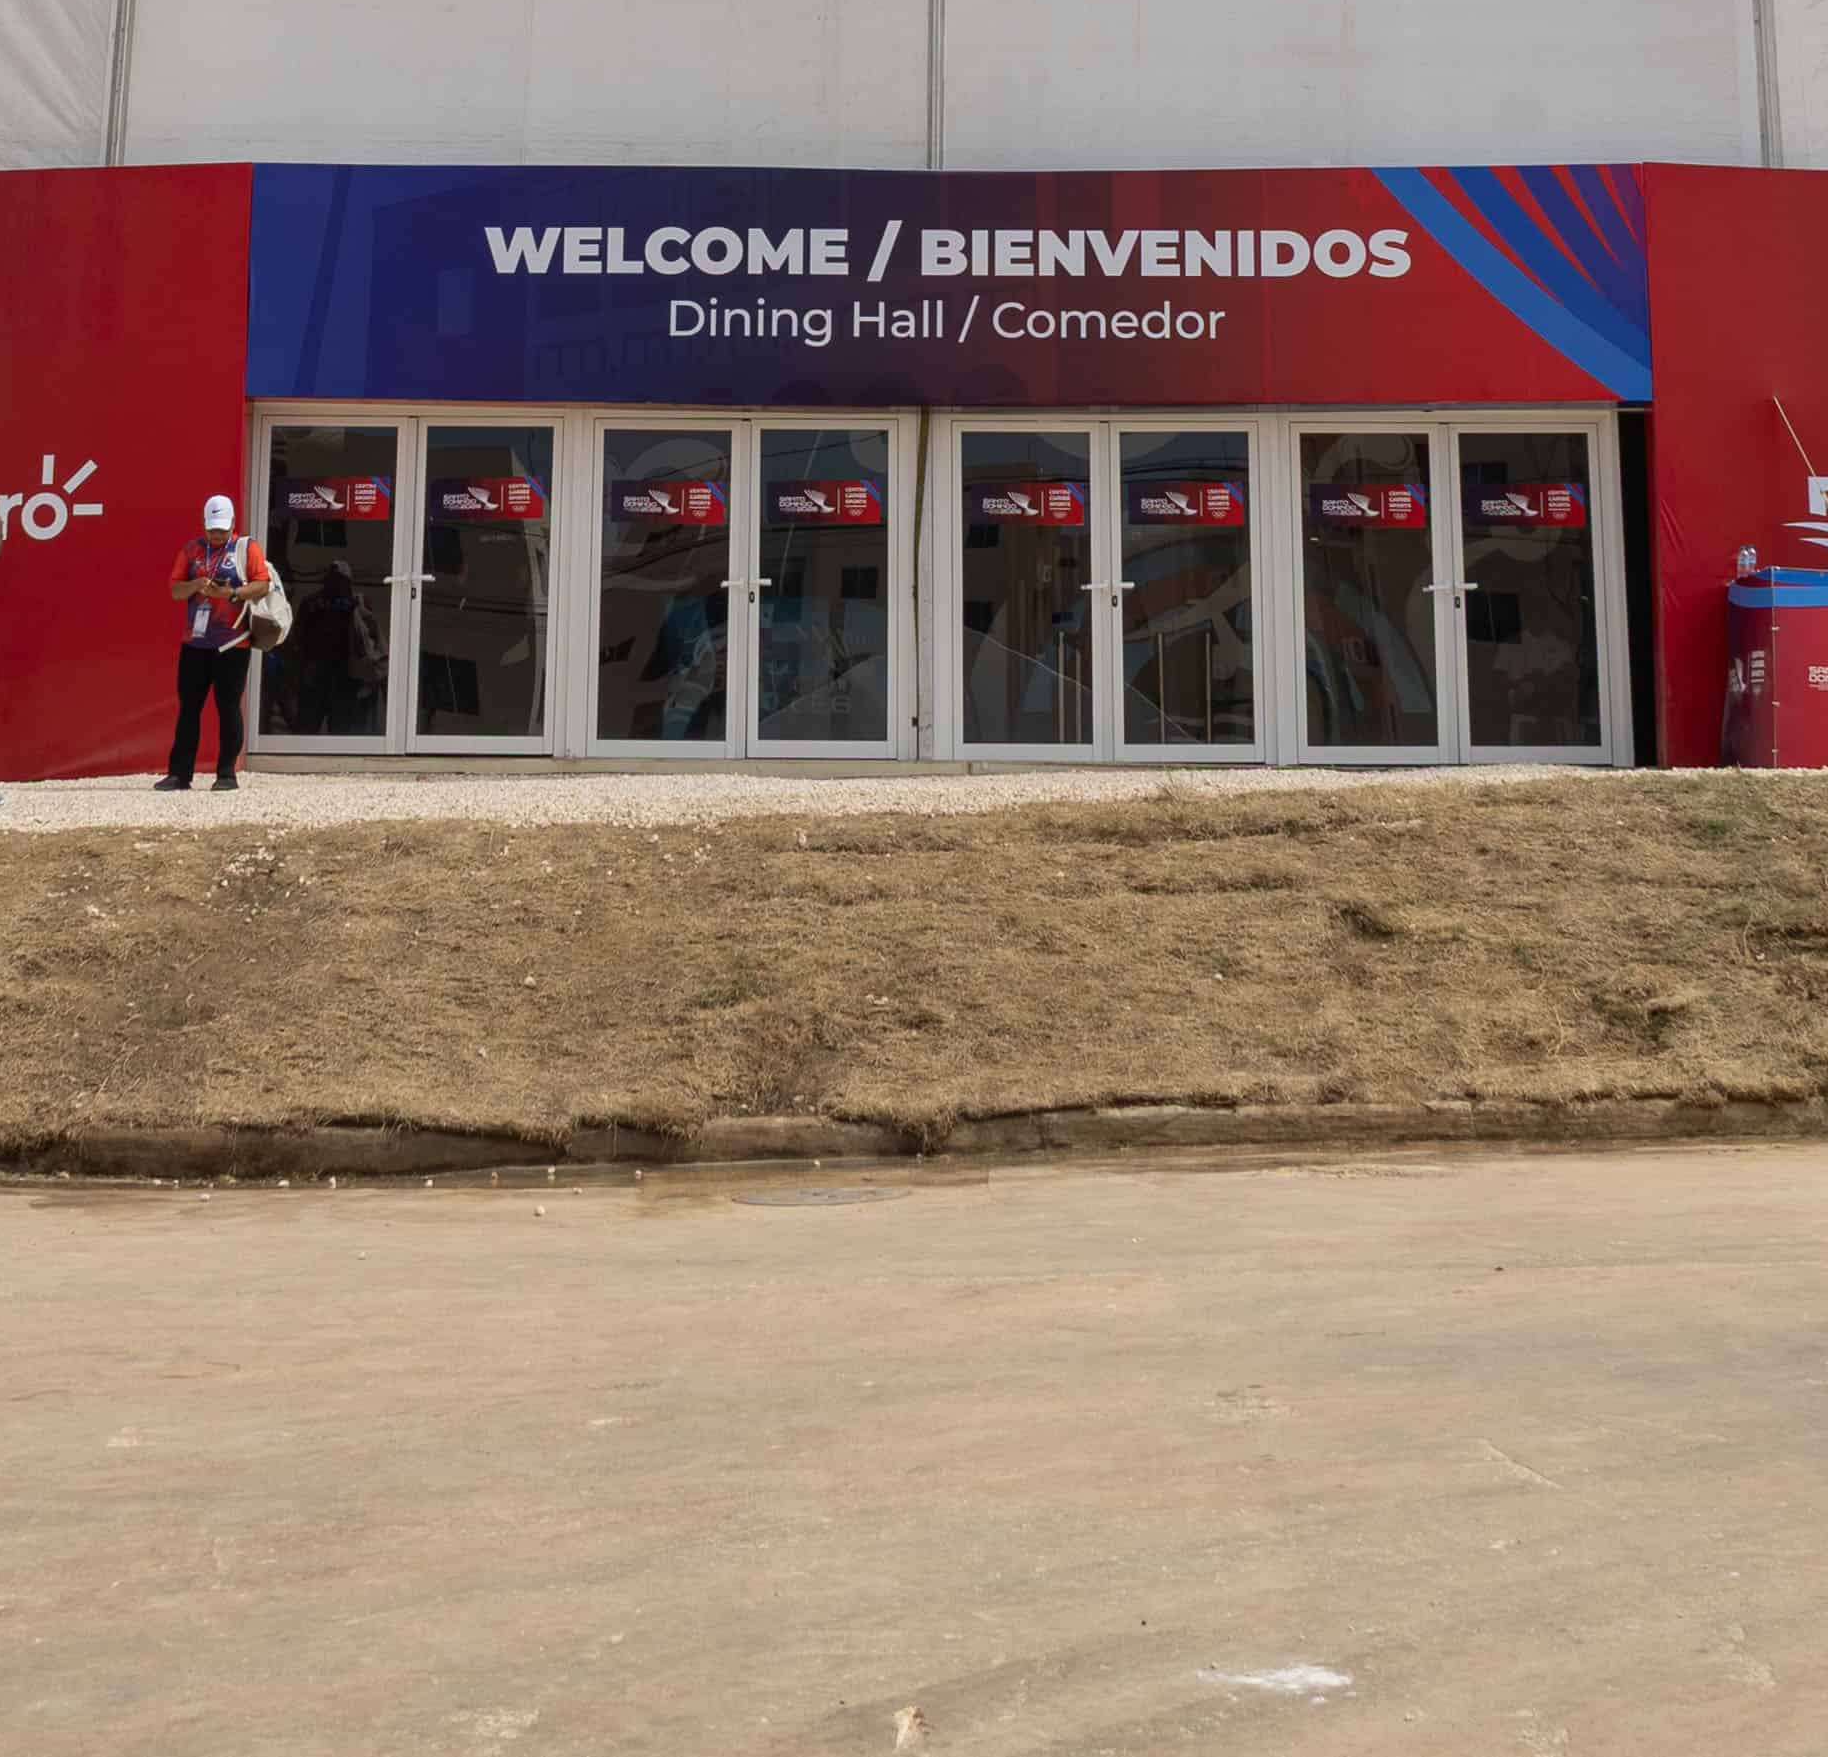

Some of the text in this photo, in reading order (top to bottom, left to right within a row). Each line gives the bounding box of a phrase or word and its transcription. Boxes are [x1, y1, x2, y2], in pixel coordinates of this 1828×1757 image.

[484, 220, 1412, 282] WELCOME / BIENVENIDOS
[669, 295, 1225, 347] Dining Hall / Comedor
